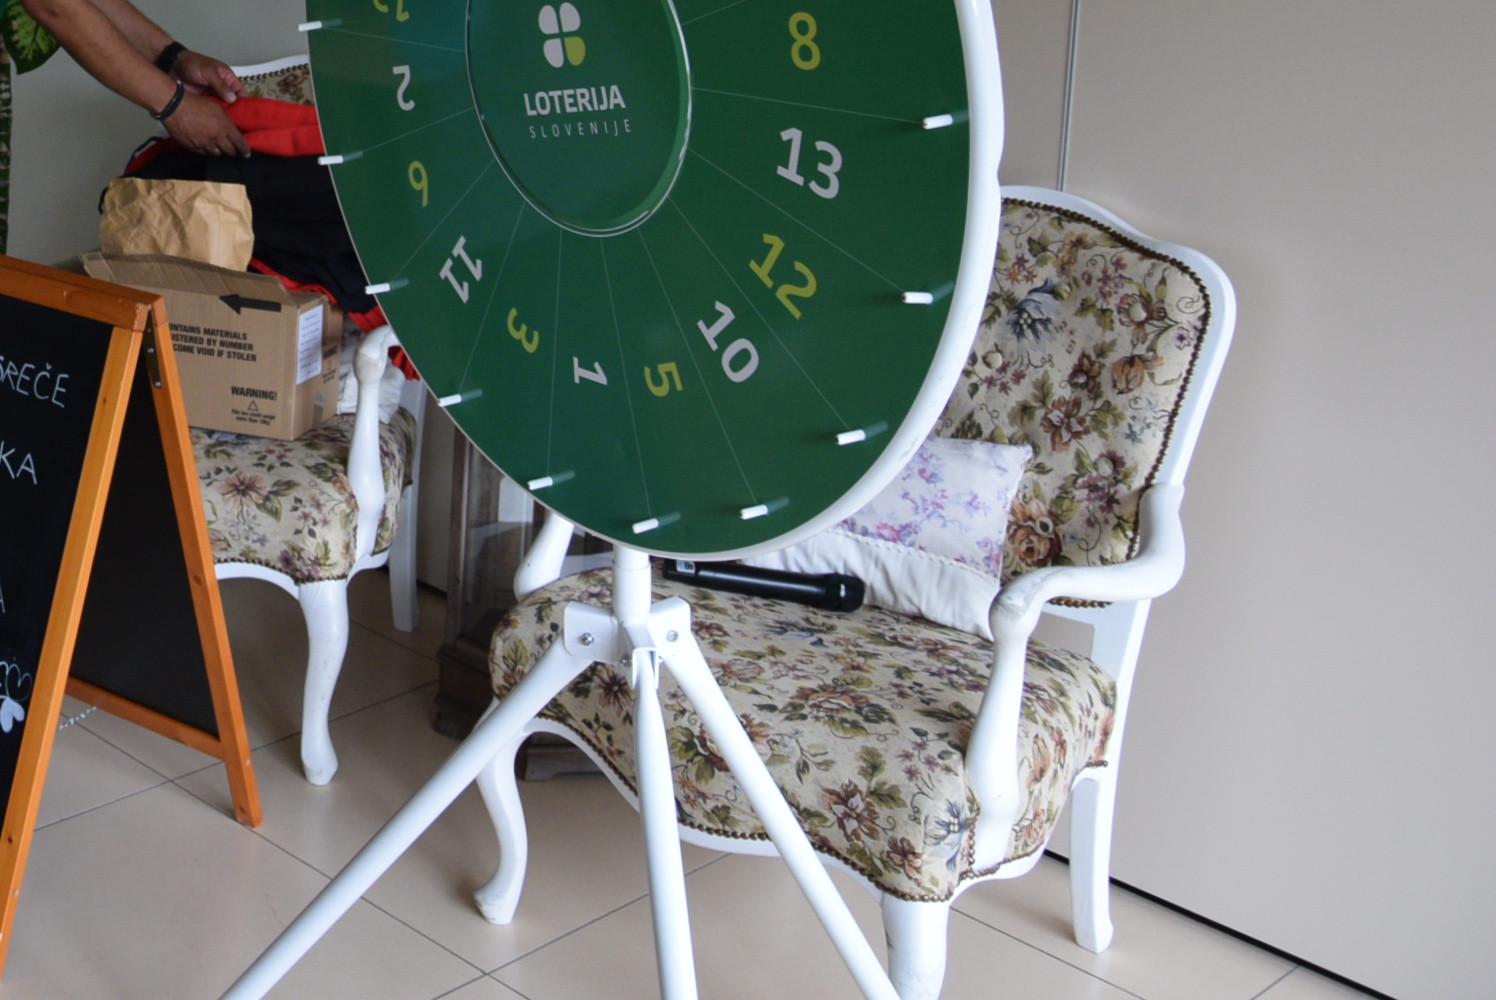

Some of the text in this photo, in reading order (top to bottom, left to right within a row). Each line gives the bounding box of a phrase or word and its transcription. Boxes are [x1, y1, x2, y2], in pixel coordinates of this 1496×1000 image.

[789, 12, 820, 70] 8
[393, 65, 415, 111] 2
[524, 85, 626, 116] LOTERIJA
[529, 119, 631, 138] SLOVENIJE
[776, 128, 843, 199] 13
[440, 236, 483, 303] 11
[750, 234, 817, 319] 12
[169, 323, 248, 341] ONTAINS MATERIALS
[206, 338, 217, 347] BY
[219, 340, 254, 352] NUMBER
[507, 307, 540, 354] 3
[697, 301, 759, 382] 10
[173, 343, 257, 362] COME VOID IF STOLEN
[572, 356, 608, 386] 1
[644, 361, 683, 397] 5
[231, 386, 278, 401] WARNING!
